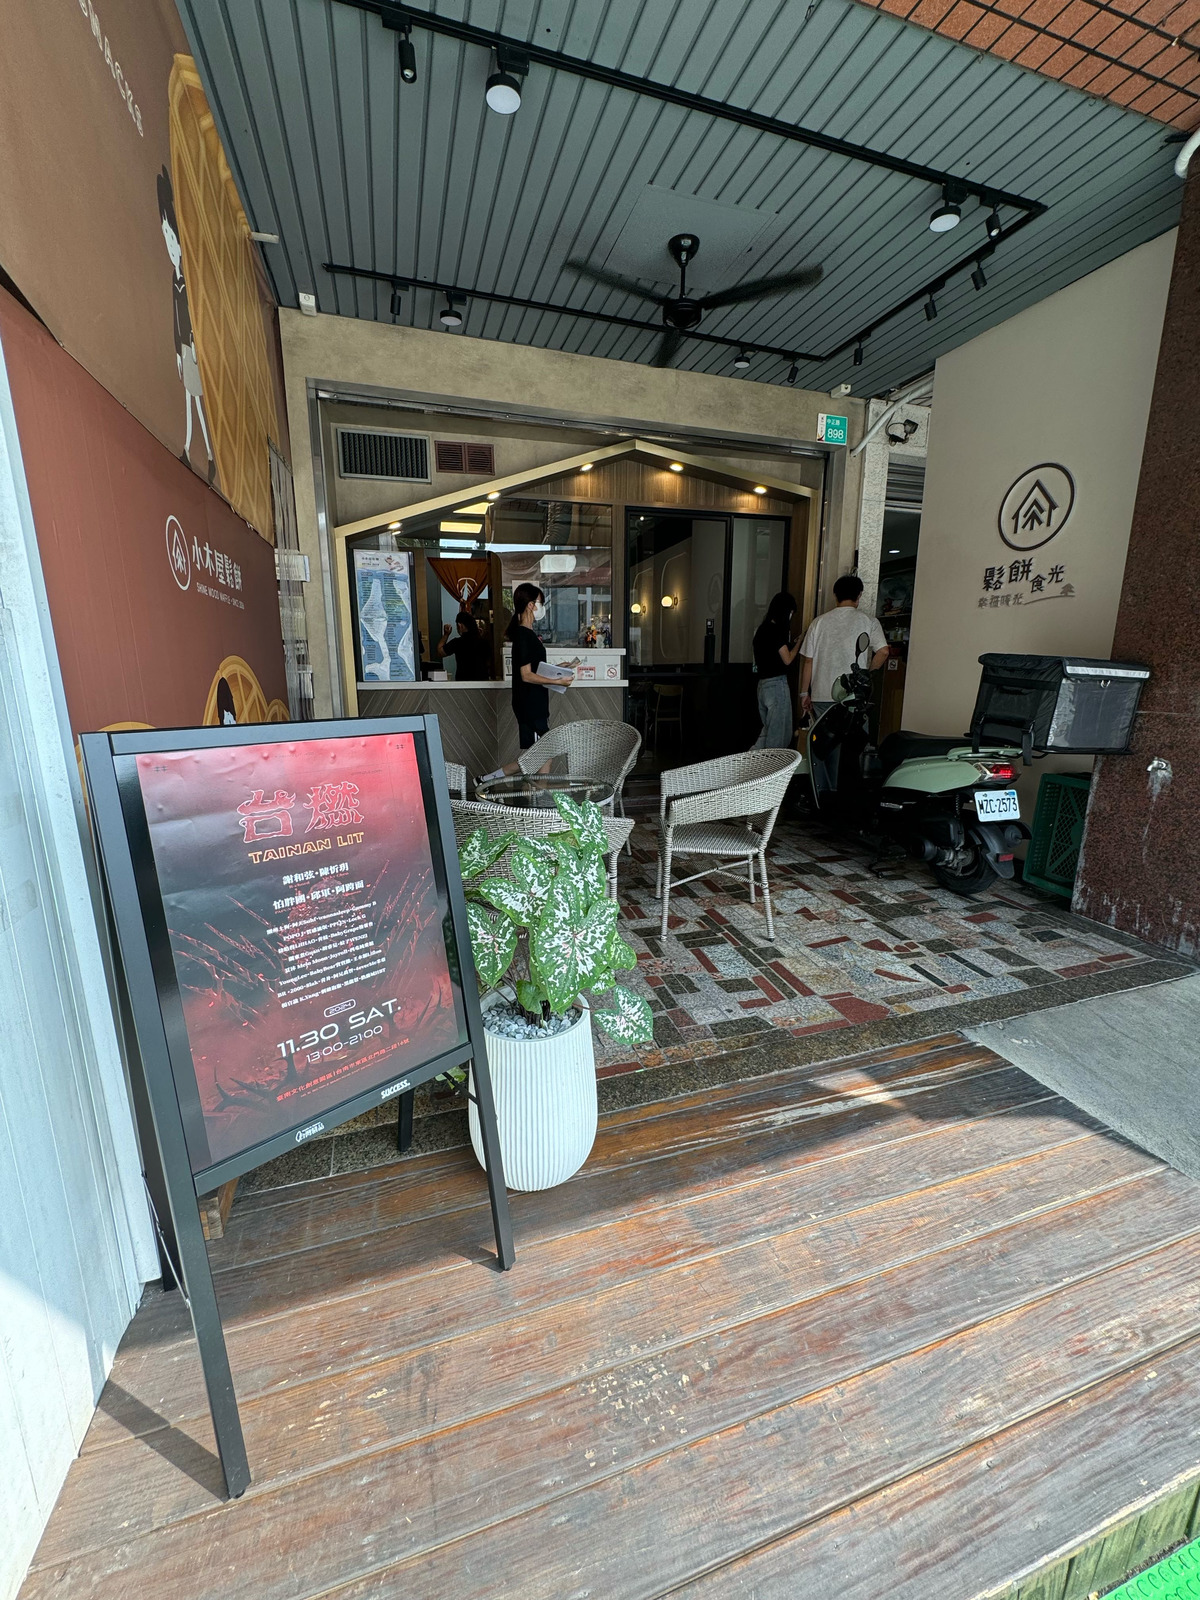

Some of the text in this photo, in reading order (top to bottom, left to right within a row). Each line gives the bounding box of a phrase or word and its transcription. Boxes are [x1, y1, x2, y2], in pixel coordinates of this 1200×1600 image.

[827, 428, 844, 439] 898
[192, 536, 243, 592] 小木屋鬆餅
[982, 557, 1065, 594] 鬆餅食光
[248, 832, 365, 865] TAINAN LIT
[329, 1002, 352, 1014] 2024
[277, 998, 402, 1058] 11.30 SAT.
